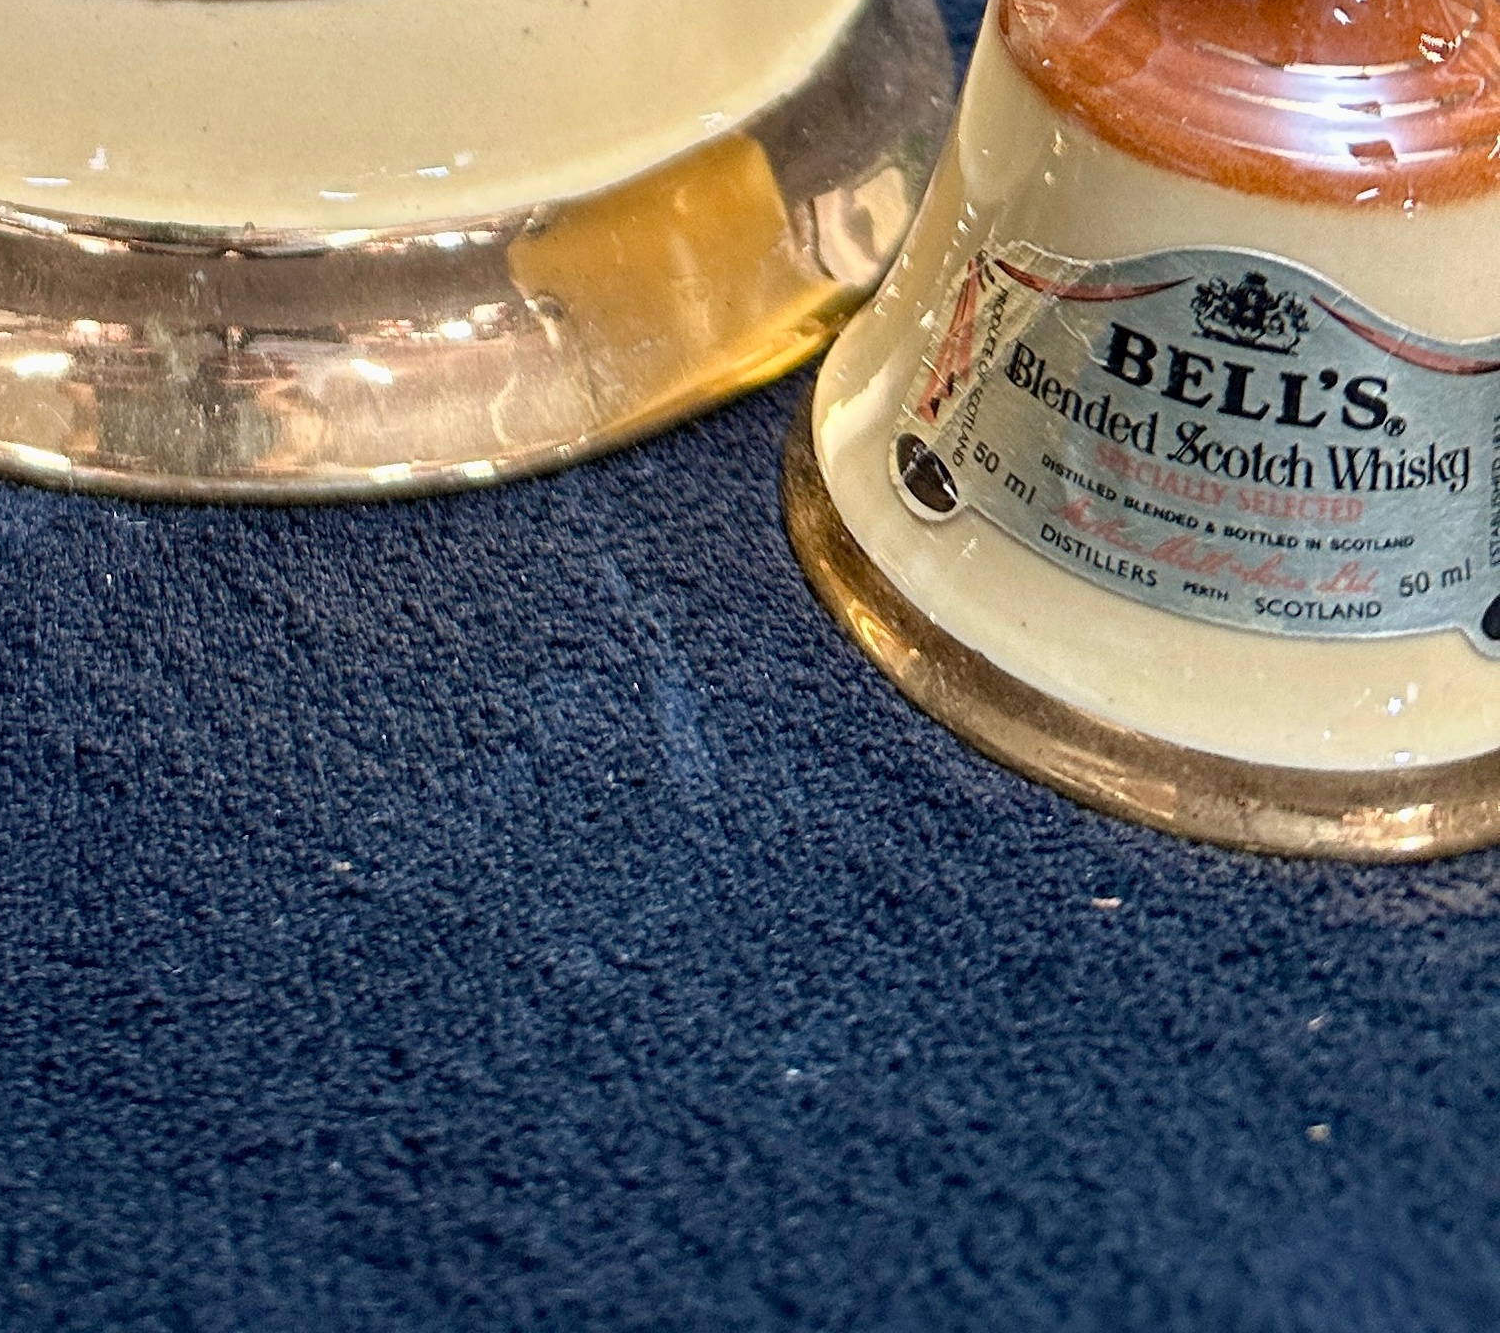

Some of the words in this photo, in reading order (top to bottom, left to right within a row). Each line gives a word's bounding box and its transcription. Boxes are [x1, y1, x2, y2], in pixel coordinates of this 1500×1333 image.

[1003, 338, 1160, 456] Blended
[1166, 420, 1315, 489] Scotch
[1326, 442, 1472, 493] Whisky
[972, 440, 1000, 475] 50
[1004, 471, 1038, 507] ml
[1041, 452, 1118, 501] DISTILLED
[1123, 494, 1199, 530] BLENDED
[1223, 524, 1299, 549] BOTTLED
[1330, 535, 1416, 552] SCOTLAND
[1236, 486, 1367, 525] SELECTED
[1040, 523, 1159, 588] DISTILLERS
[1182, 580, 1230, 602] PERTH
[1255, 595, 1383, 621] SCOTLAND
[1400, 570, 1430, 598] 50
[1441, 556, 1472, 588] ml
